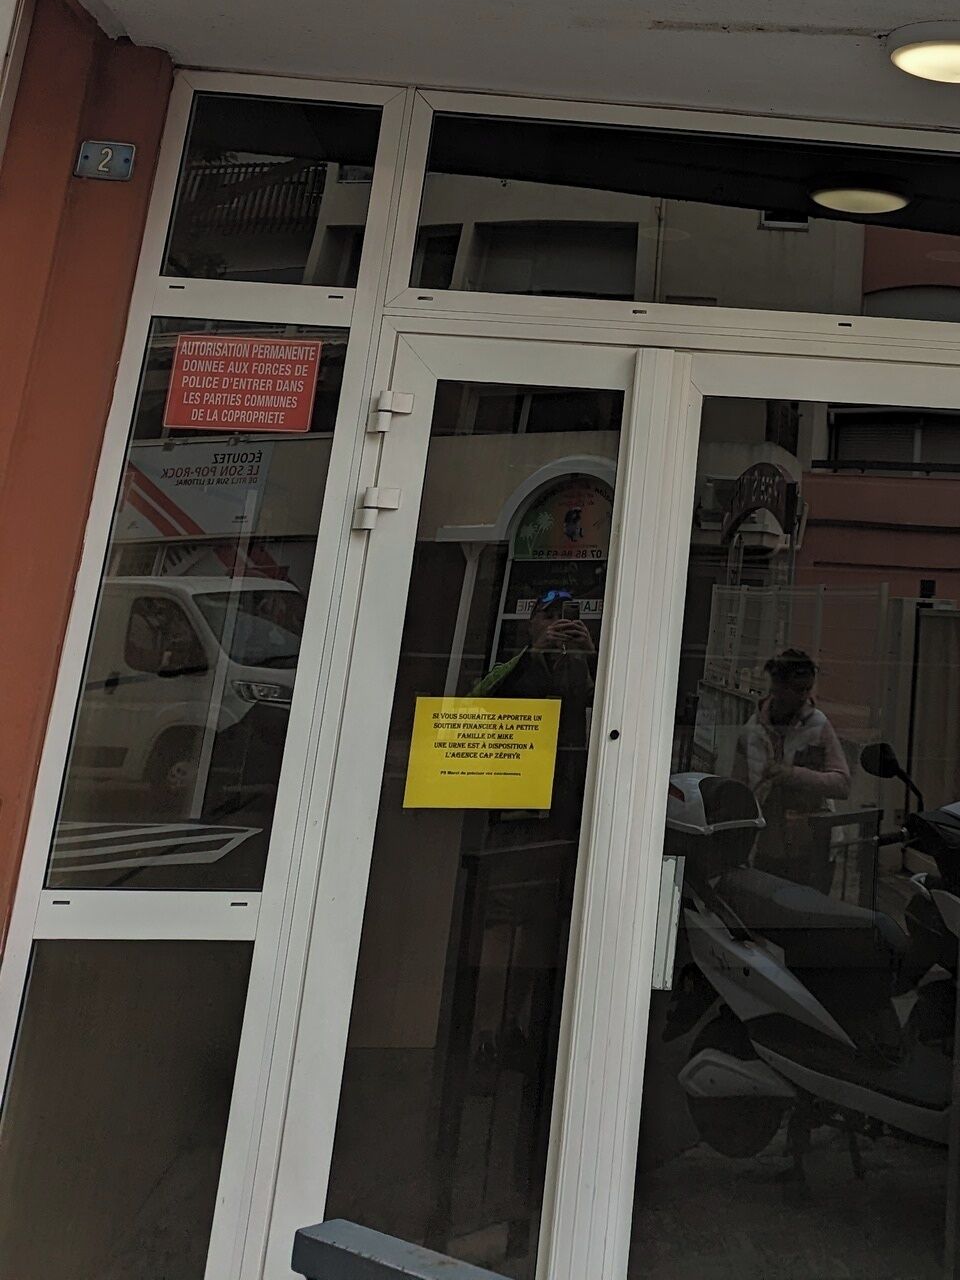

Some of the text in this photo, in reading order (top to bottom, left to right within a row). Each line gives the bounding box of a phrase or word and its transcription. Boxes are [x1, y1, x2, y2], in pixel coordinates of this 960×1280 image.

[98, 148, 112, 171] 2
[181, 341, 316, 361] AUTORISATION PERMANENTE
[183, 360, 309, 377] DONNEE AUX FORCES DE
[182, 376, 304, 393] POLICE D'ENTRER DANS
[183, 392, 297, 408] LES PARTIES COMMUNES
[191, 408, 286, 424] DE LA COPROPRIETE
